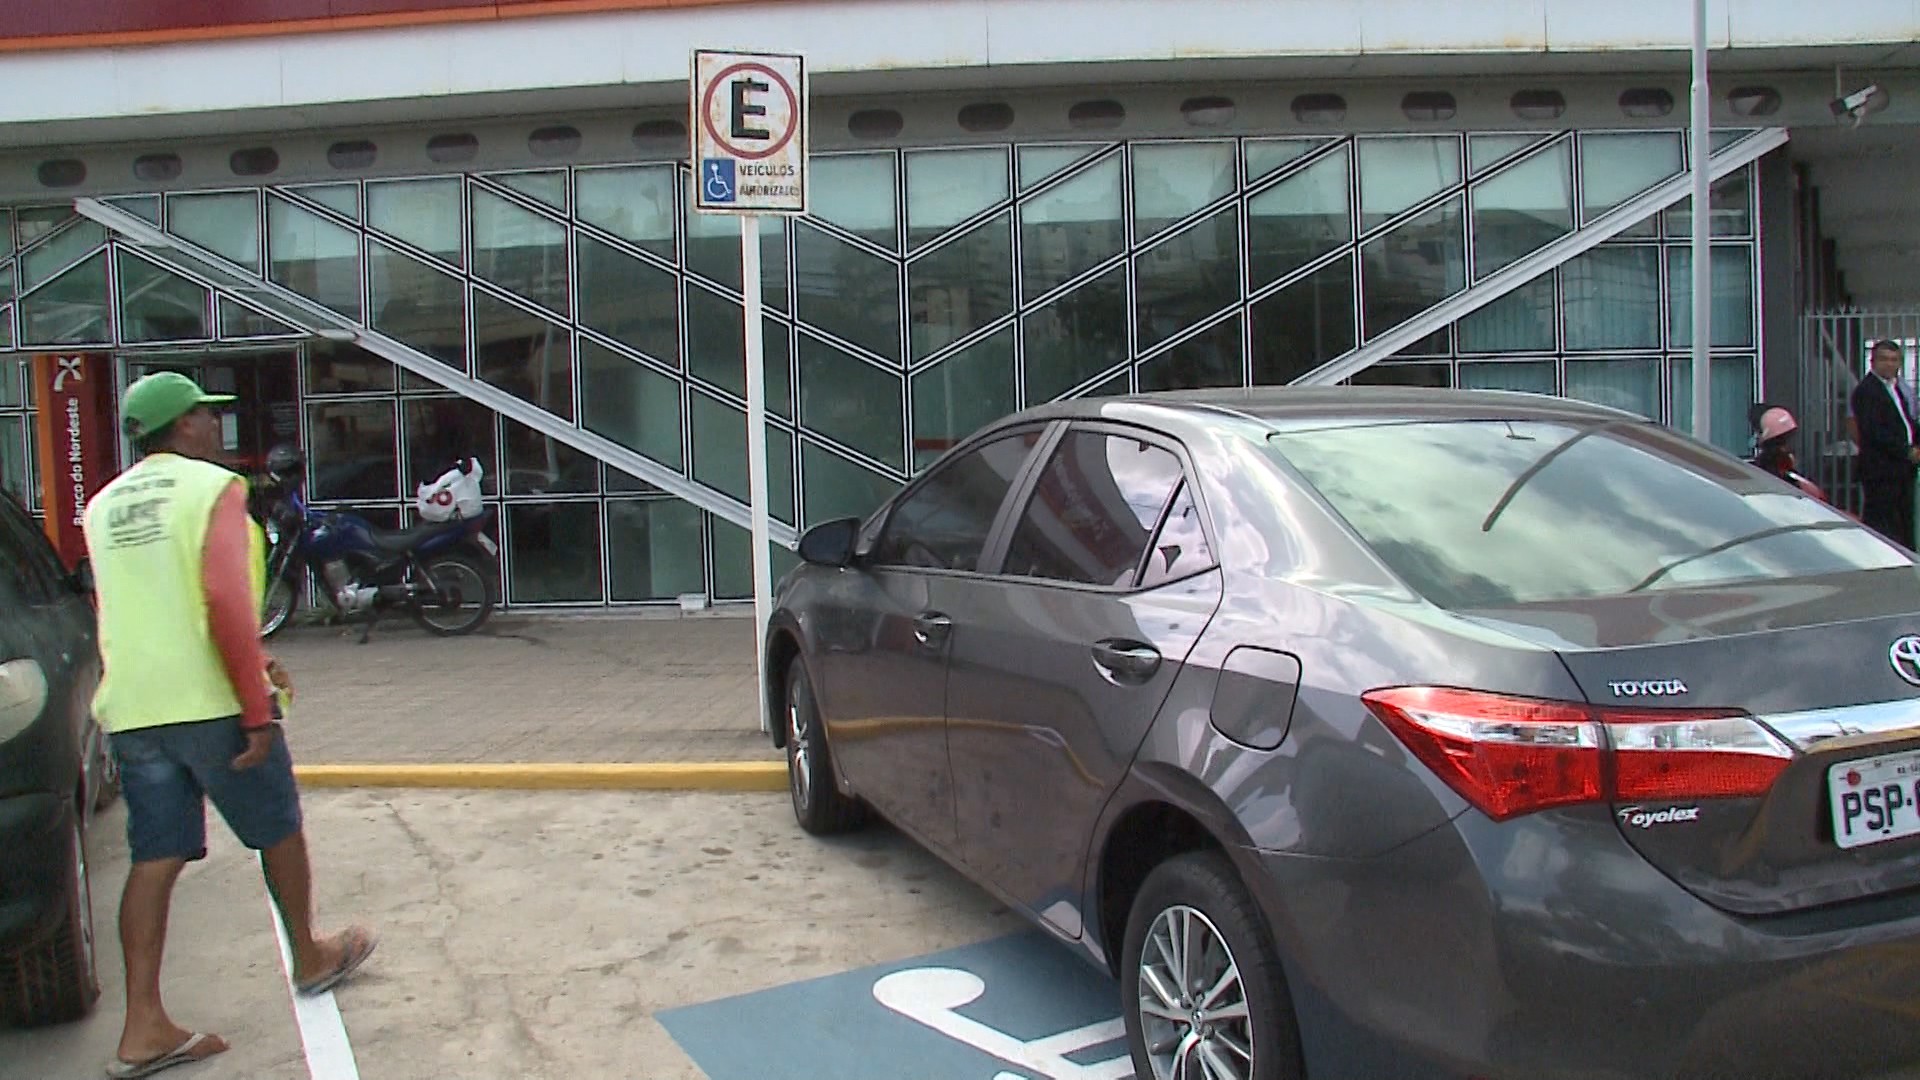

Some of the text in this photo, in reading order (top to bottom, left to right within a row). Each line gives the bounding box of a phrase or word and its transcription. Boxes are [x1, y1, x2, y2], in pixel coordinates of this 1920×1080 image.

[731, 80, 770, 140] E
[739, 162, 795, 177] VEÍCULOS
[65, 397, 86, 527] Banco do Nordeste
[1608, 679, 1689, 697] TOYOTA
[1617, 804, 1700, 828] Toyolex
